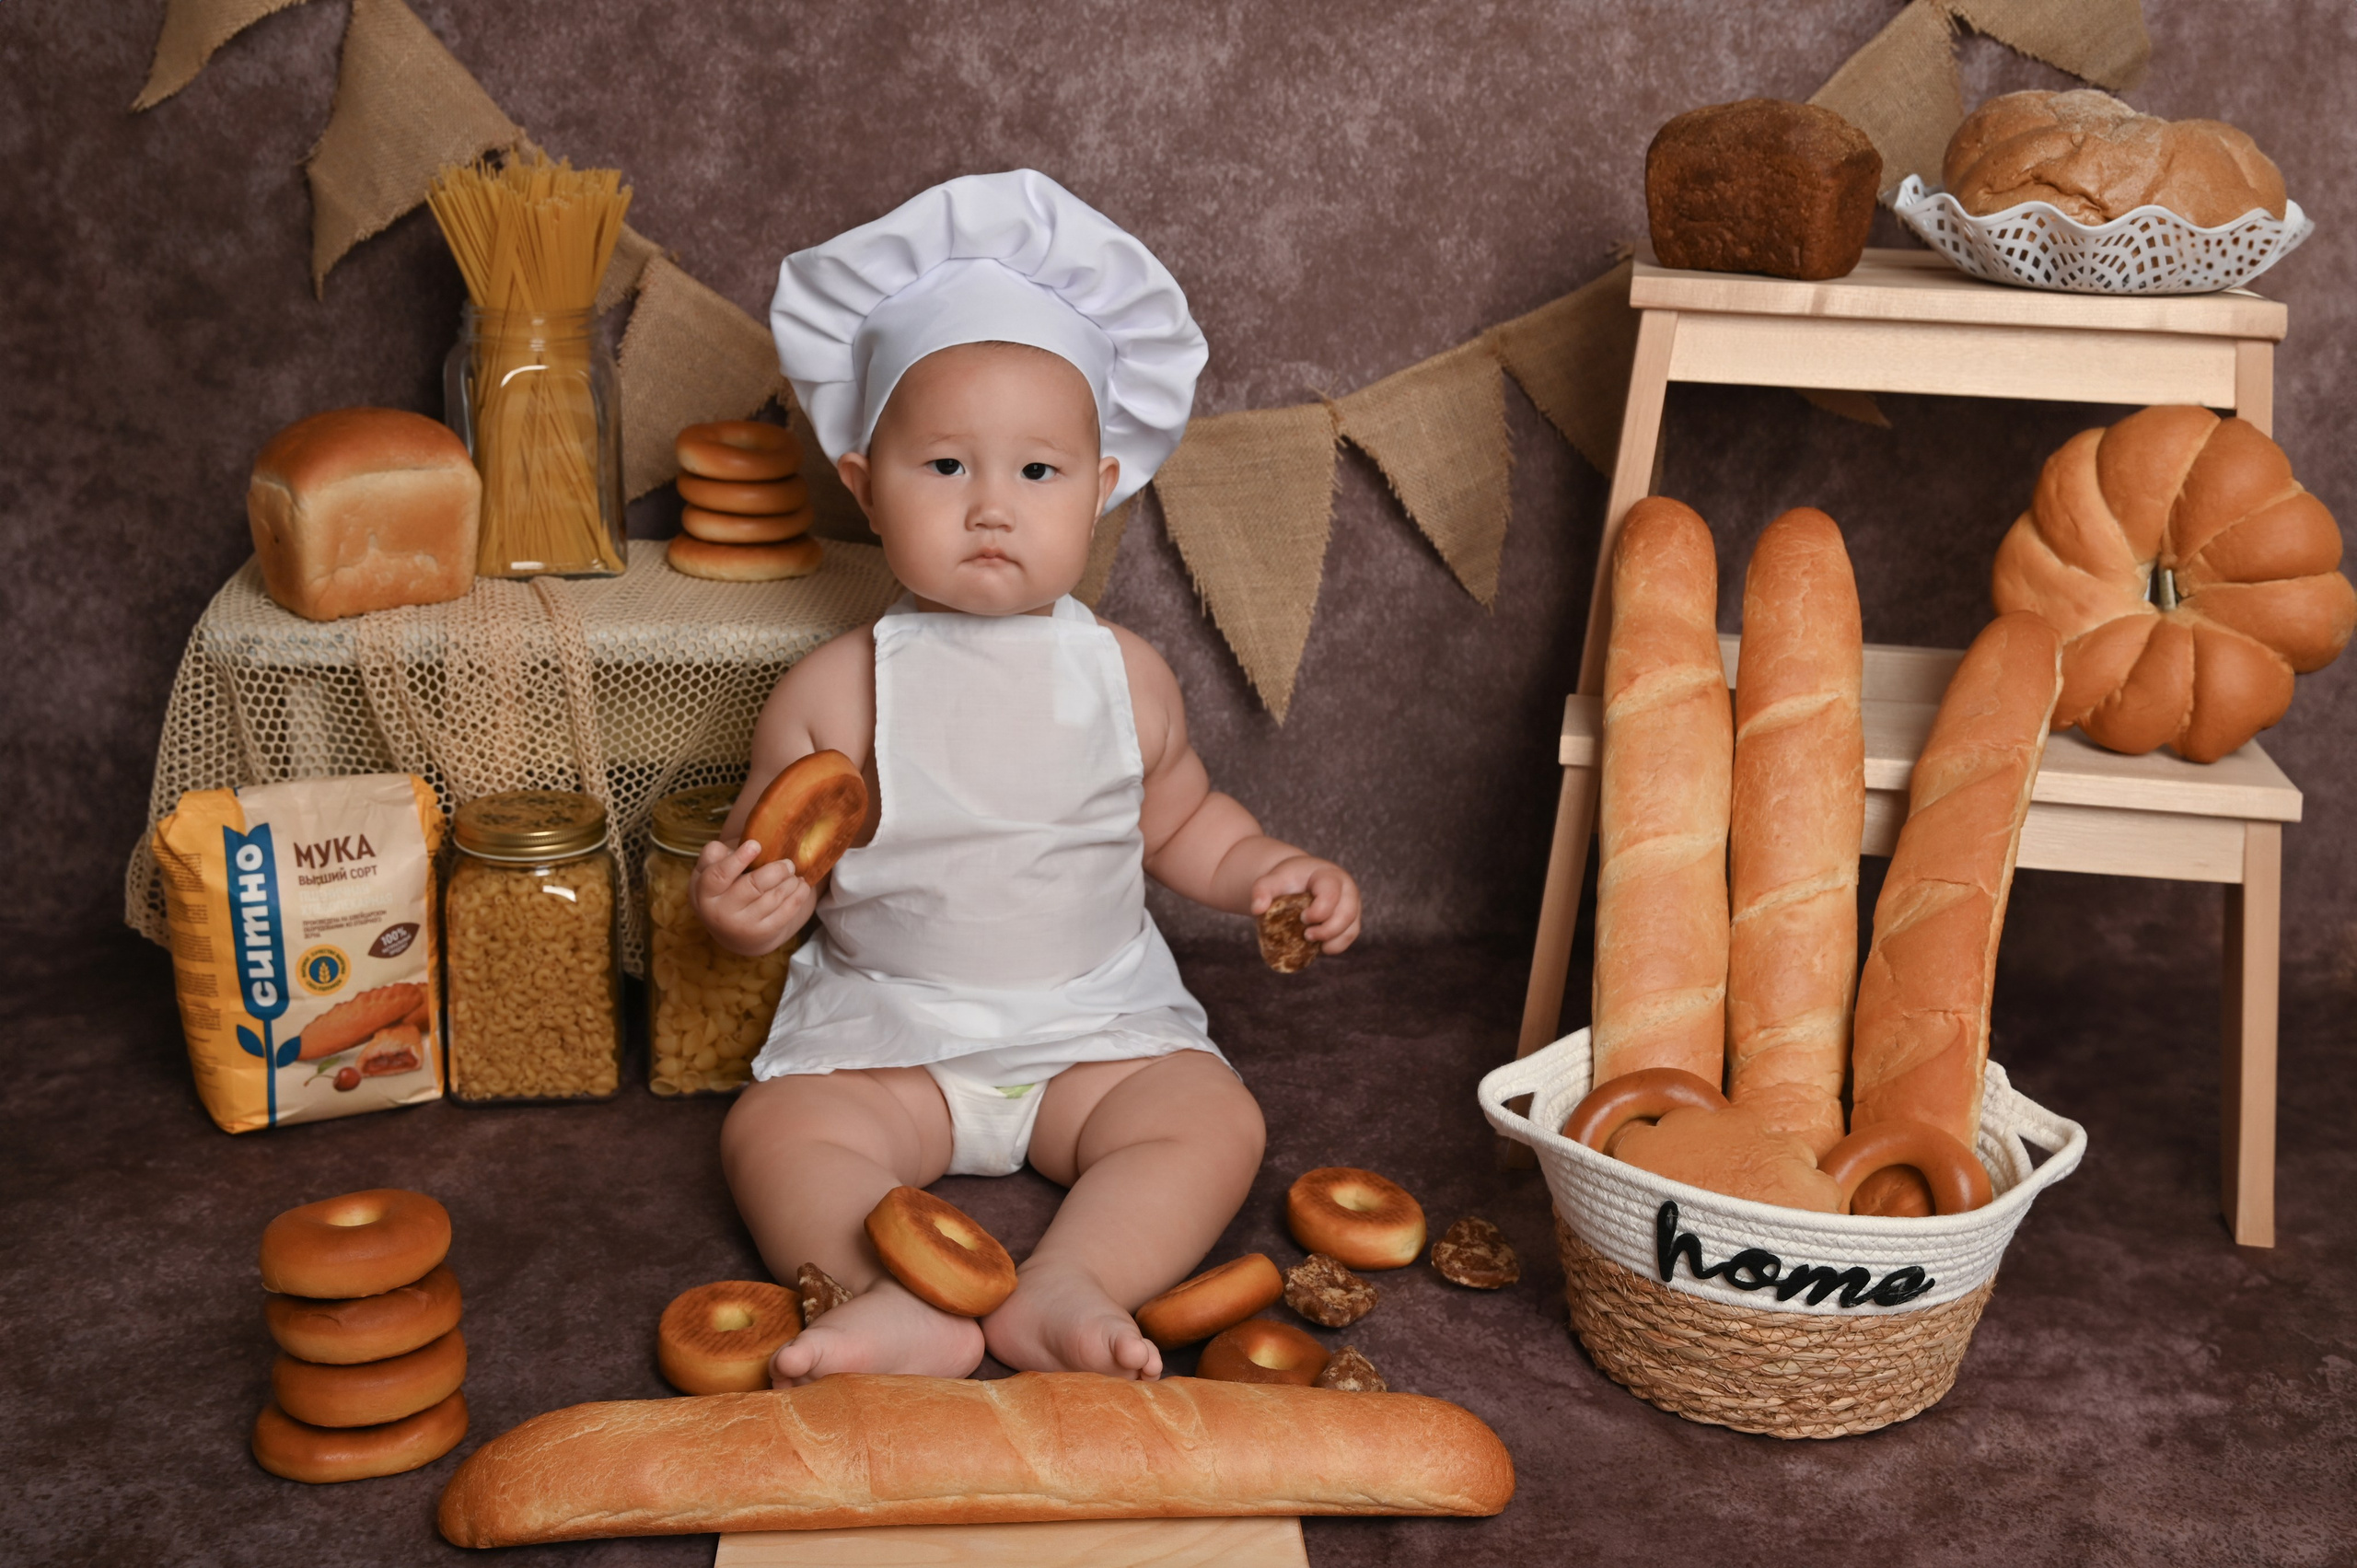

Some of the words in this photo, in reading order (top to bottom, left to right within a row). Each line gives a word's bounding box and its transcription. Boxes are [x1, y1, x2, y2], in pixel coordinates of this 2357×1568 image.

[293, 833, 377, 869] МУКА
[350, 865, 378, 879] СОРТ
[380, 925, 408, 947] 100%
[1657, 1201, 1936, 1308] home
